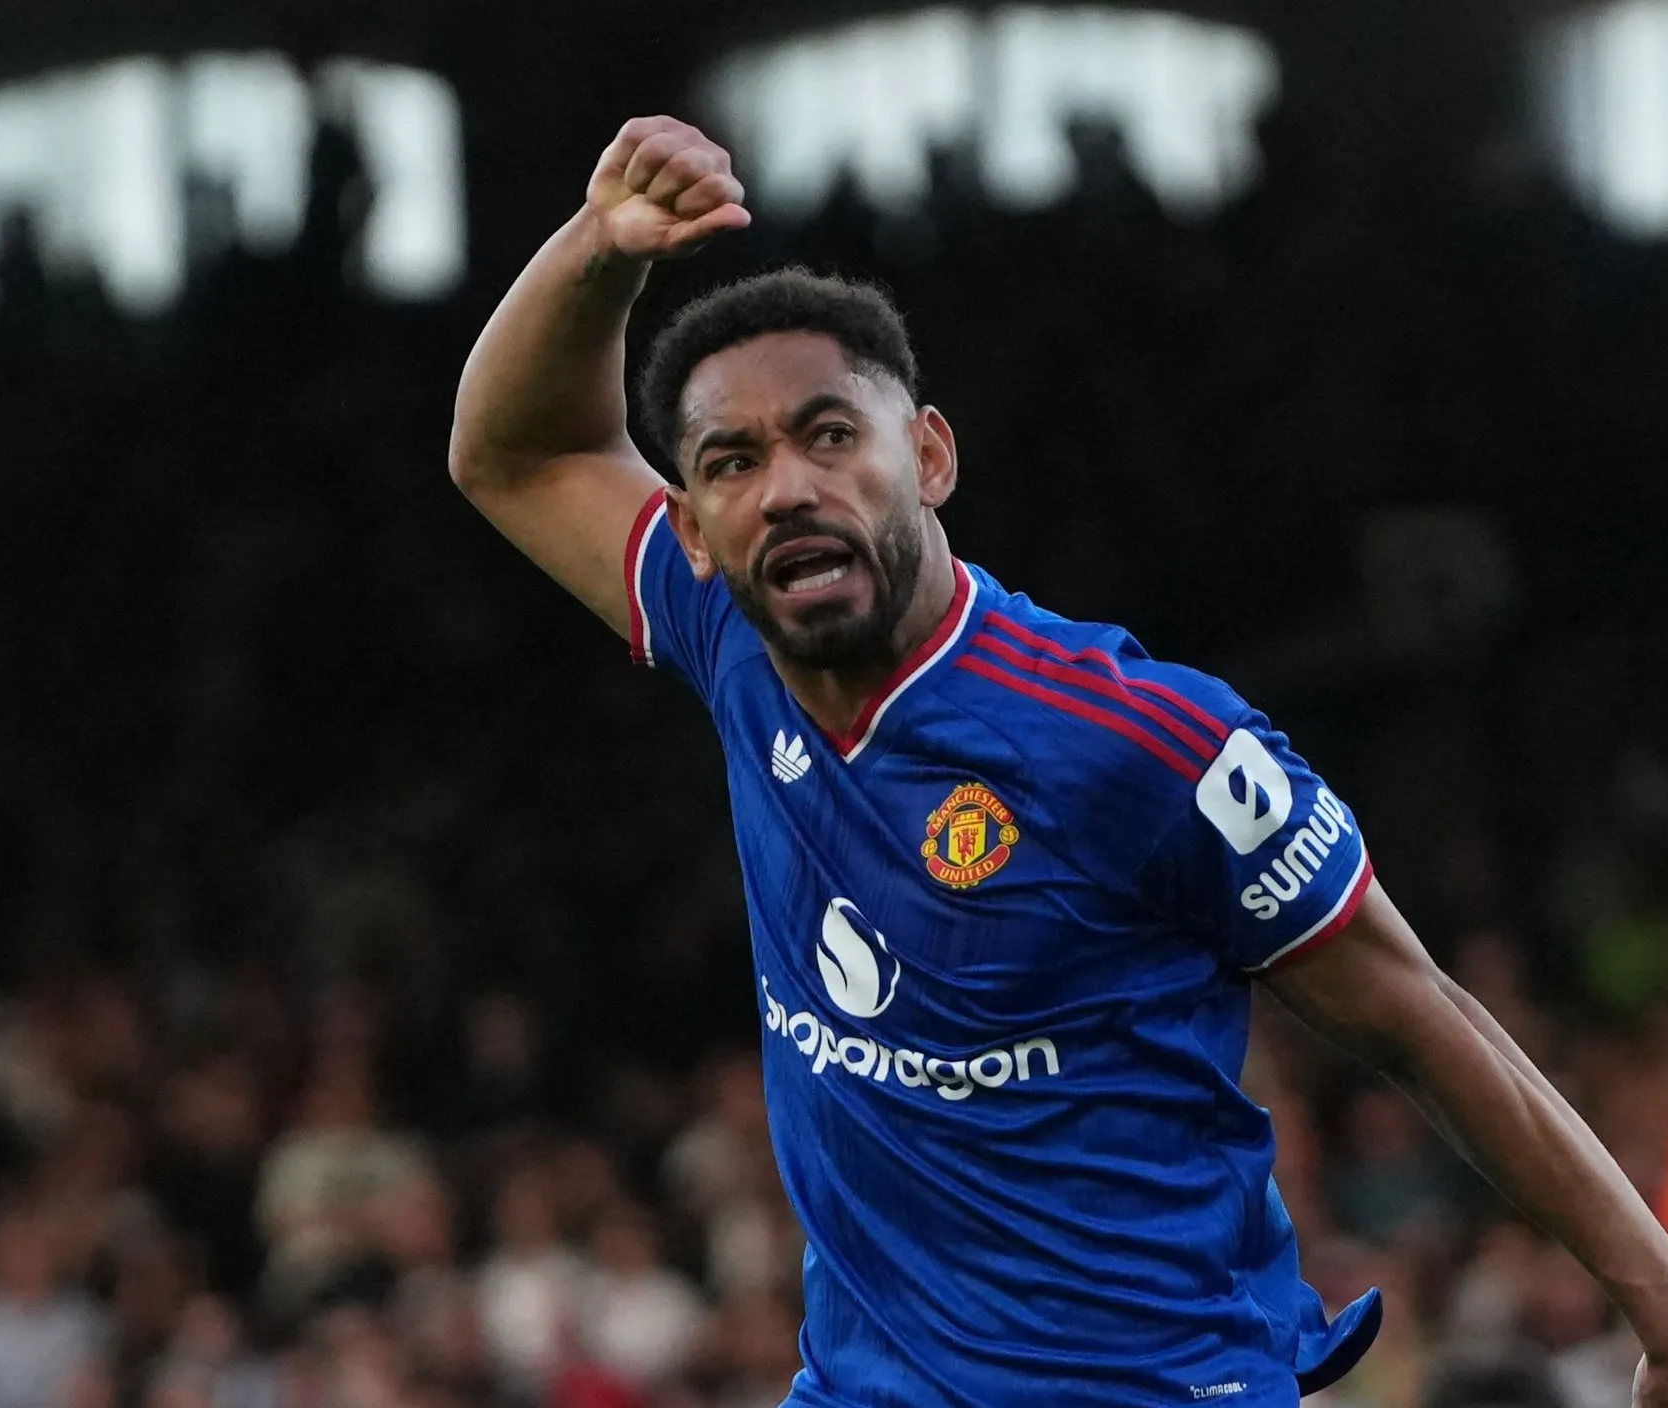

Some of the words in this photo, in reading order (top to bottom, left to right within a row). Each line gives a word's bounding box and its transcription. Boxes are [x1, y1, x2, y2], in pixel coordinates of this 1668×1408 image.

[932, 789, 1009, 831] MANCHESTER
[1240, 786, 1353, 920] sumup
[939, 859, 995, 881] UNITED
[1193, 1382, 1243, 1399] CLIMACOOL
